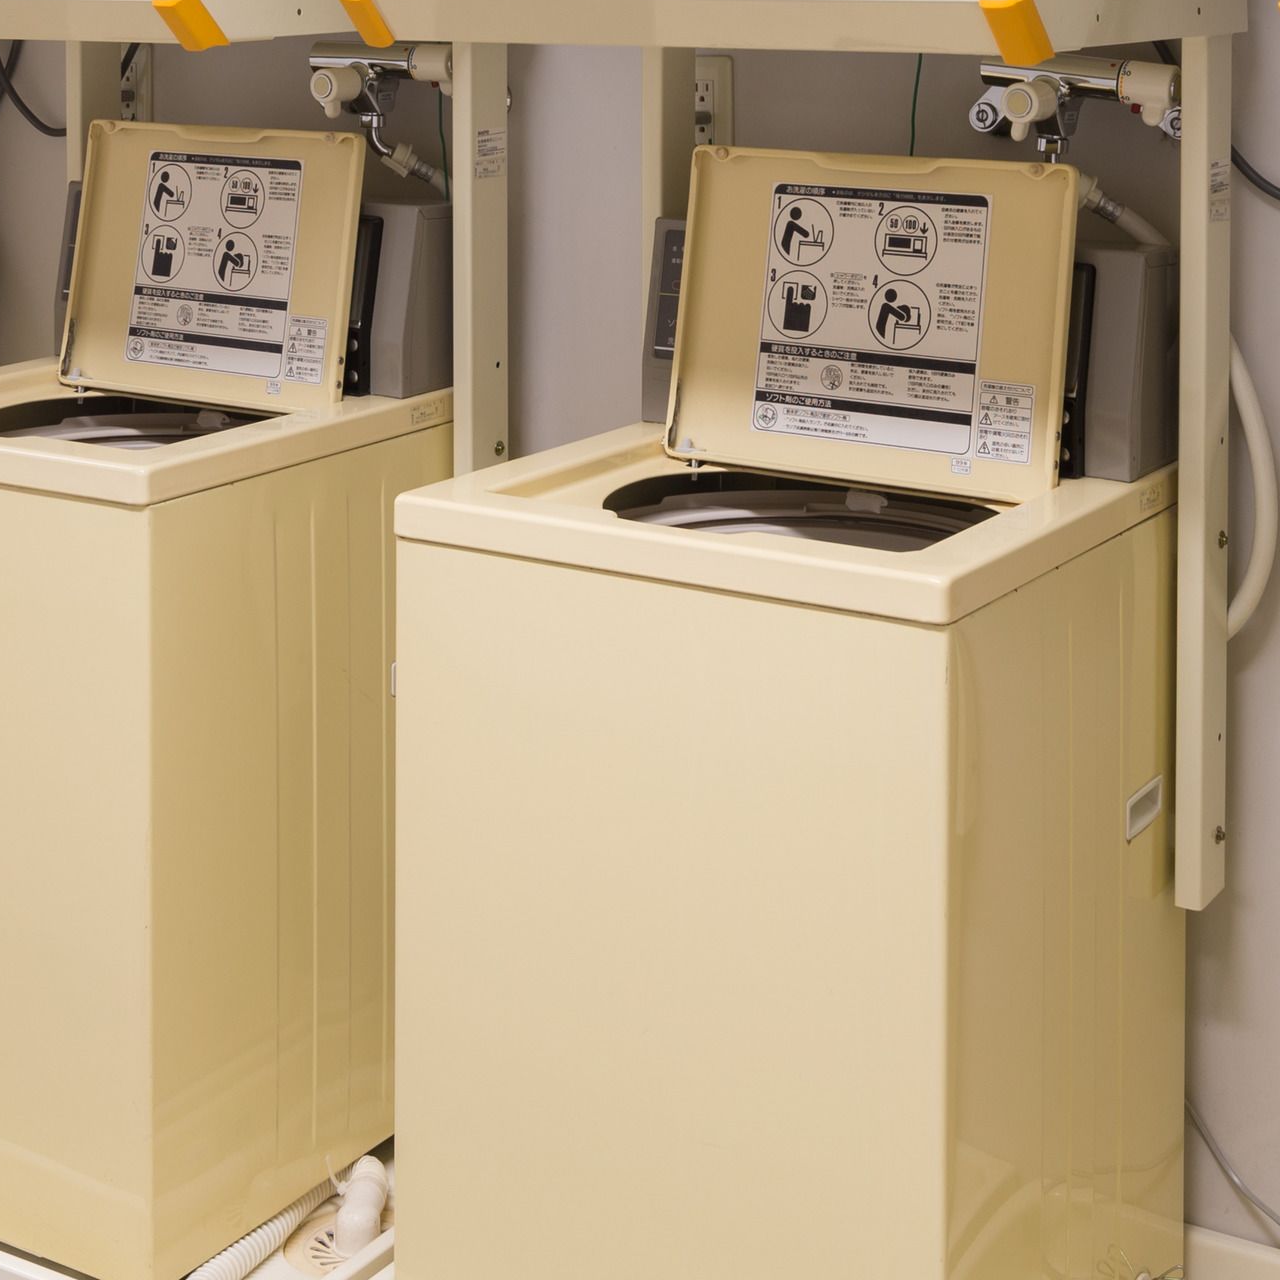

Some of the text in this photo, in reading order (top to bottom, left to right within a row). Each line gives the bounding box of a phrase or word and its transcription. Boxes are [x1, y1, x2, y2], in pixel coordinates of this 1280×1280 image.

[152, 163, 156, 173] 1
[224, 167, 229, 179] 2
[777, 196, 782, 209] 1
[878, 202, 885, 216] 2
[145, 224, 149, 235] 3
[889, 219, 917, 230] 50 100
[218, 228, 222, 239] 4
[770, 269, 776, 282] 3
[872, 275, 878, 288] 4
[765, 393, 832, 408] ソフト剤のご使用方法
